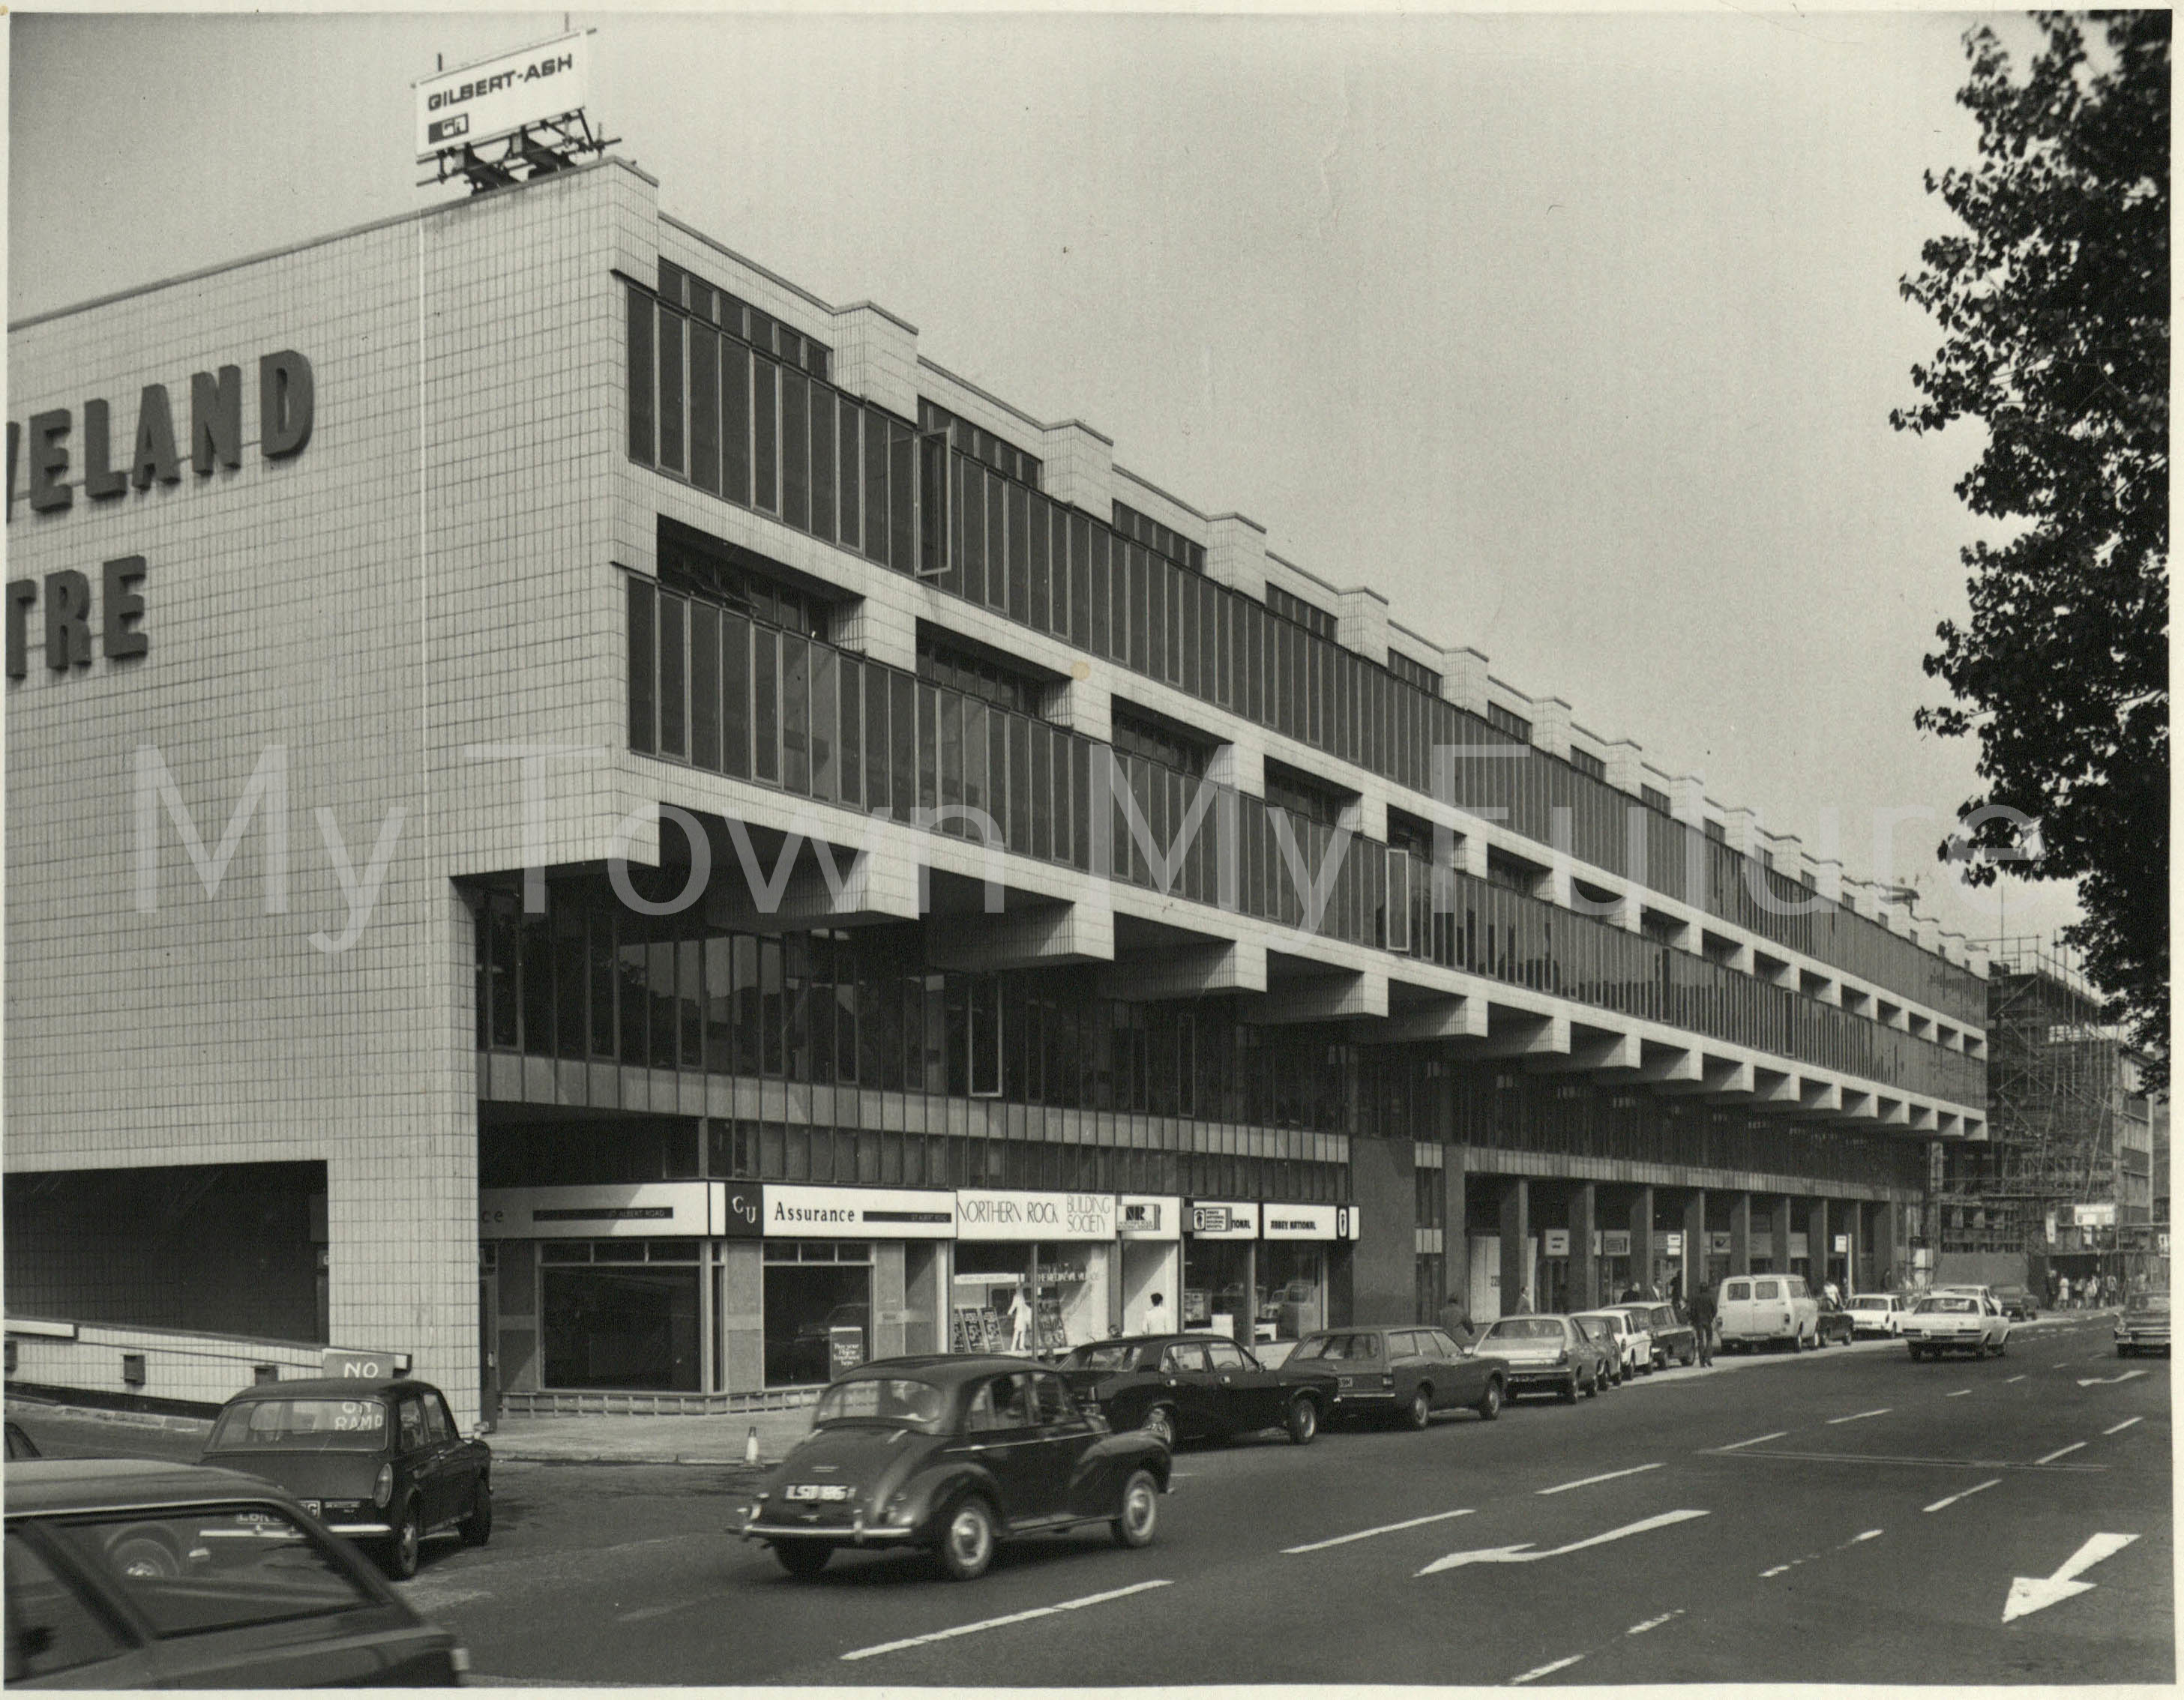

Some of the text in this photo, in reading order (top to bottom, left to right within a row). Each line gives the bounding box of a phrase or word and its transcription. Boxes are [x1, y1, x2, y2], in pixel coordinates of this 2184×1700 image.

[427, 52, 573, 112] GILBERT-ASH
[774, 1201, 855, 1222] Assurance
[957, 1200, 1059, 1224] NORTHERN ROCK
[1067, 1195, 1110, 1214] BUILDING
[1067, 1214, 1107, 1233] SOCIETY
[343, 1362, 379, 1378] NO
